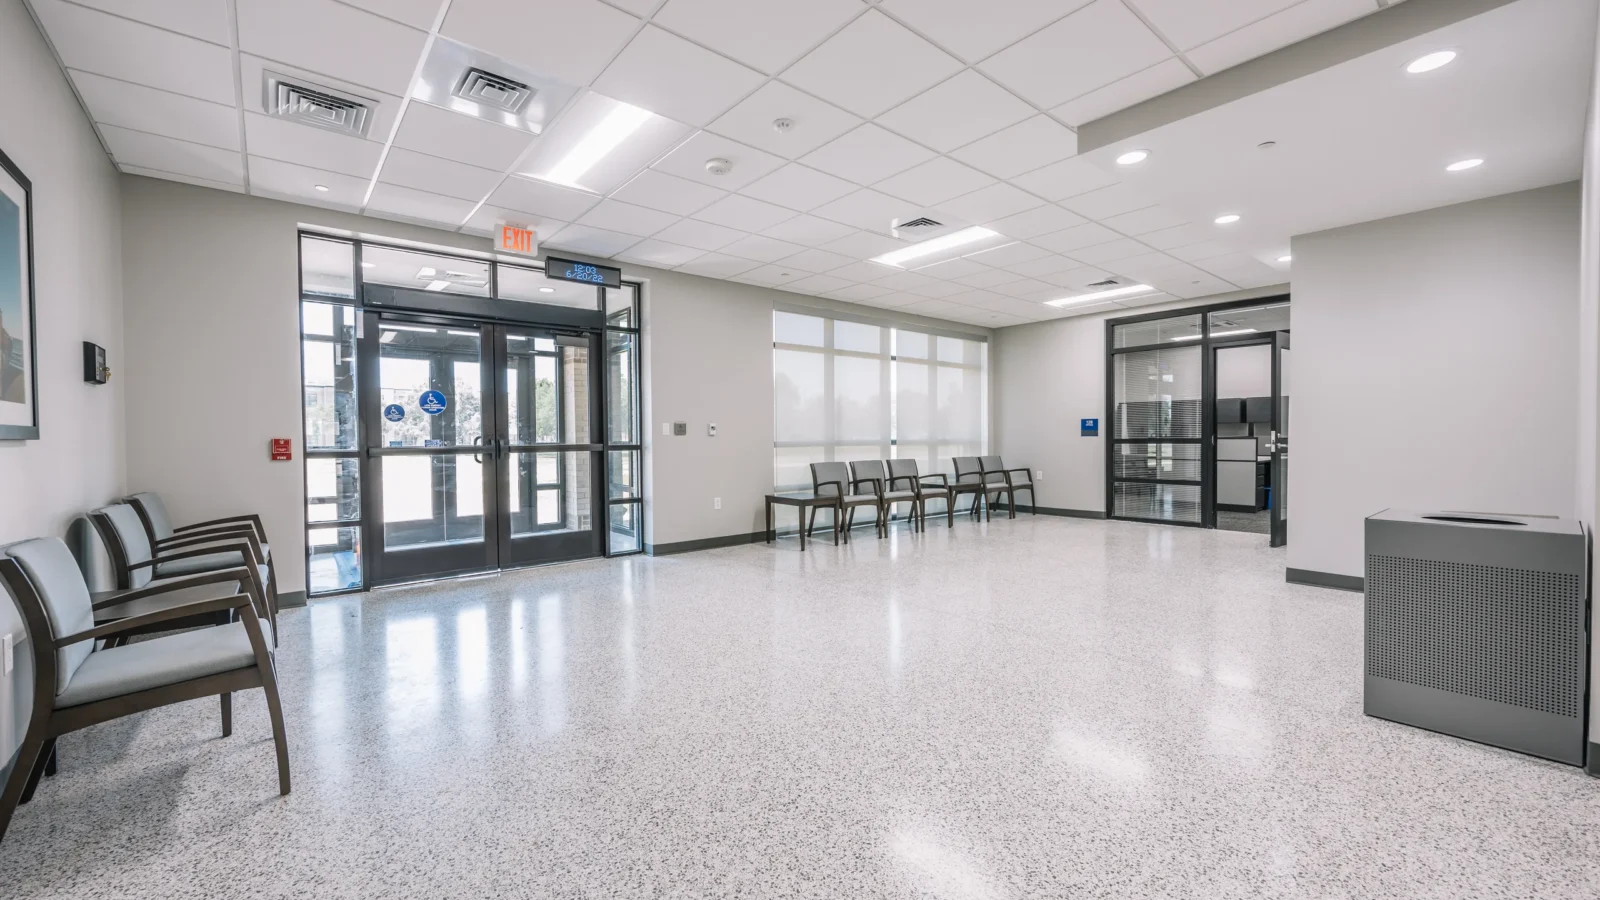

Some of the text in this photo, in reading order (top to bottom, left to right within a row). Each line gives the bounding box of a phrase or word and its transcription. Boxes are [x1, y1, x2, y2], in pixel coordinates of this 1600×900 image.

[503, 225, 533, 253] EXIT
[574, 264, 597, 275] 12:03
[565, 270, 603, 283] 6/20/22
